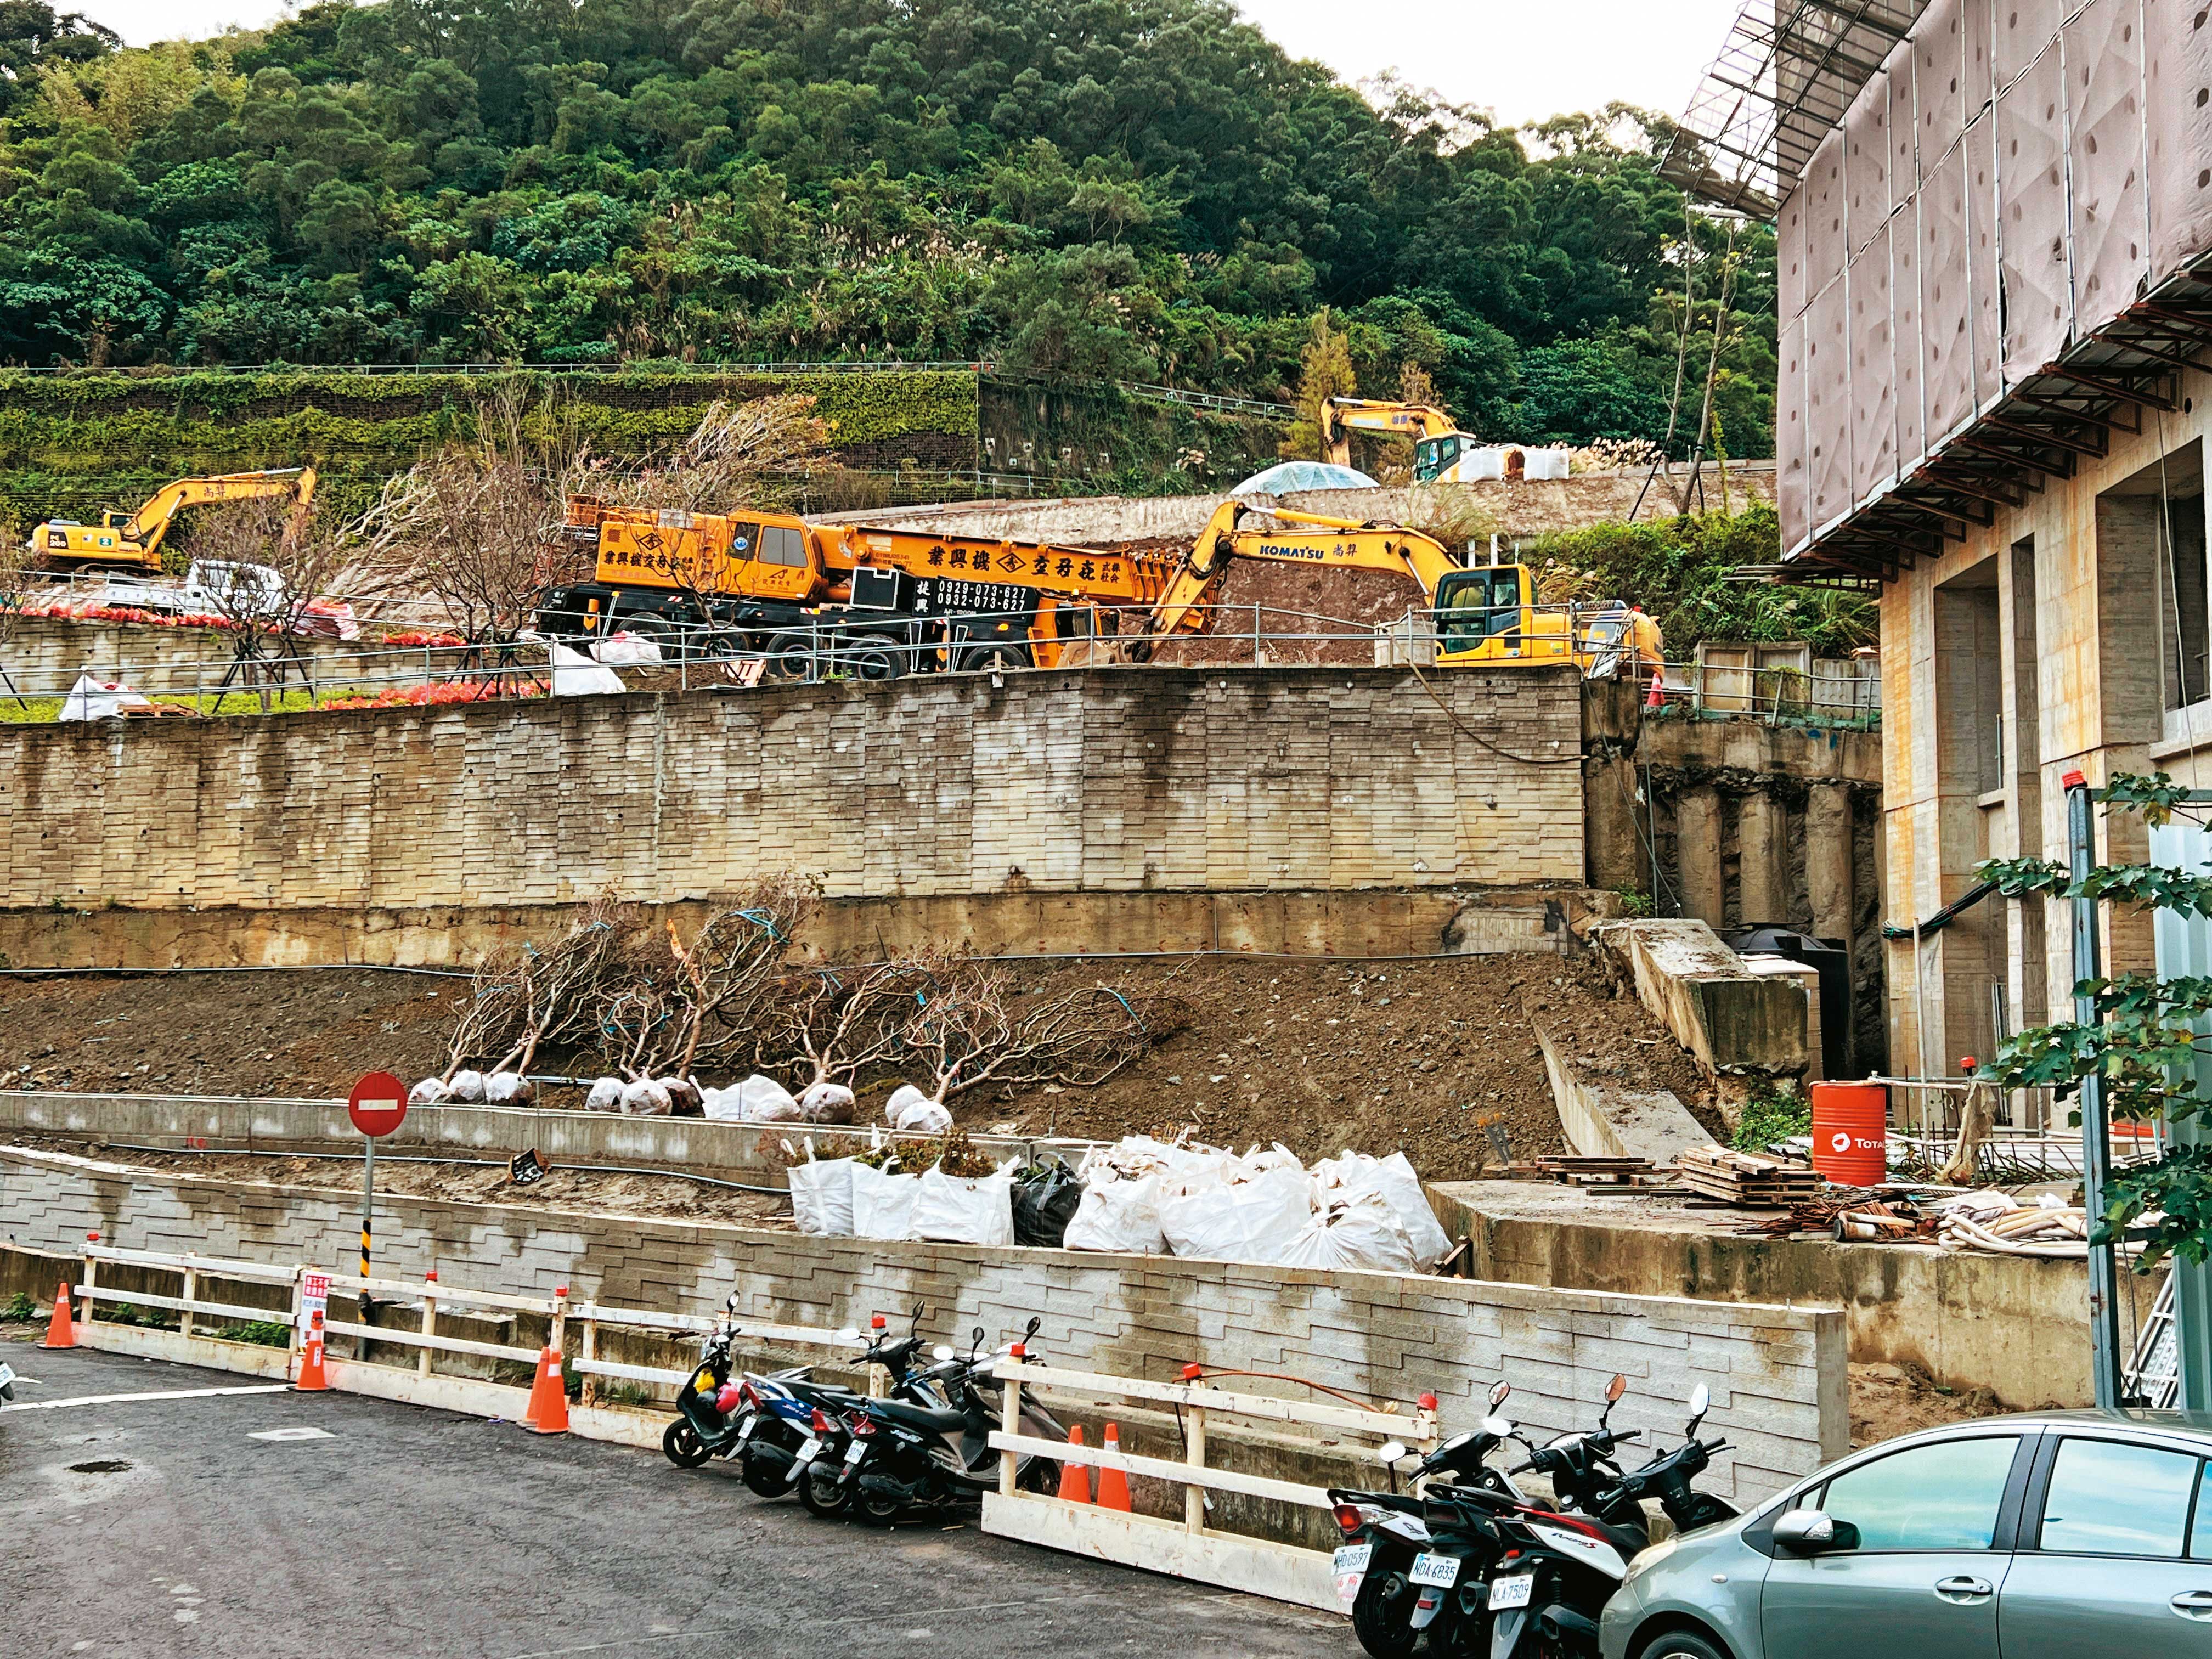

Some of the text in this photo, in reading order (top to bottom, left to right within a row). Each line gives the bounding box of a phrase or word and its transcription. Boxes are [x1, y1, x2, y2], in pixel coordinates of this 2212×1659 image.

[1259, 545, 1325, 560] KOMATSU
[1412, 1561, 1457, 1581] NDA-6835
[1491, 1584, 1530, 1602] NLA-7509
